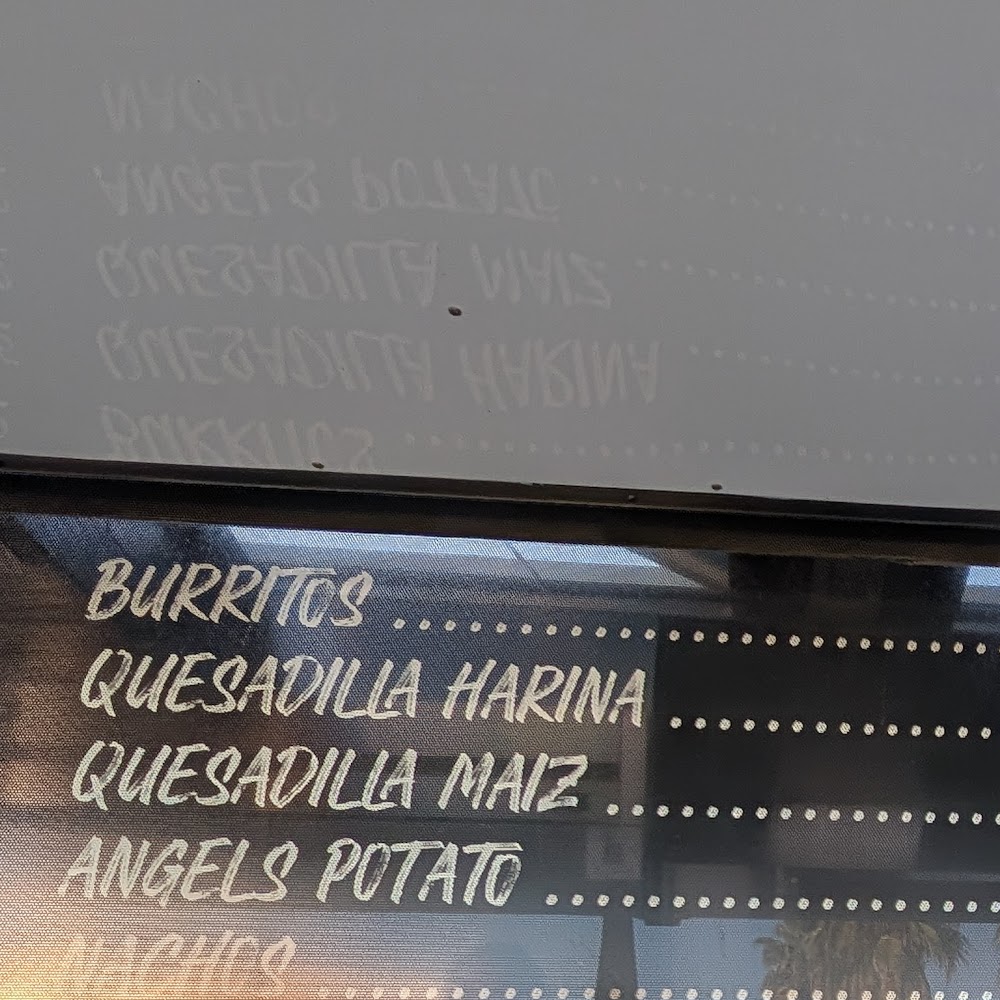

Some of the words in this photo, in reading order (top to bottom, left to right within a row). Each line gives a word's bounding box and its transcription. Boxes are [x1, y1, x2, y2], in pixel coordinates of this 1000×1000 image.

[85, 557, 373, 629] BURRITOS
[80, 648, 422, 719] QUESADILLA
[442, 659, 647, 728] HARINA
[71, 740, 417, 811] QUESADILLA
[437, 753, 589, 814] MAIZ
[57, 835, 299, 906] ANGELS
[316, 838, 524, 907] POTATO
